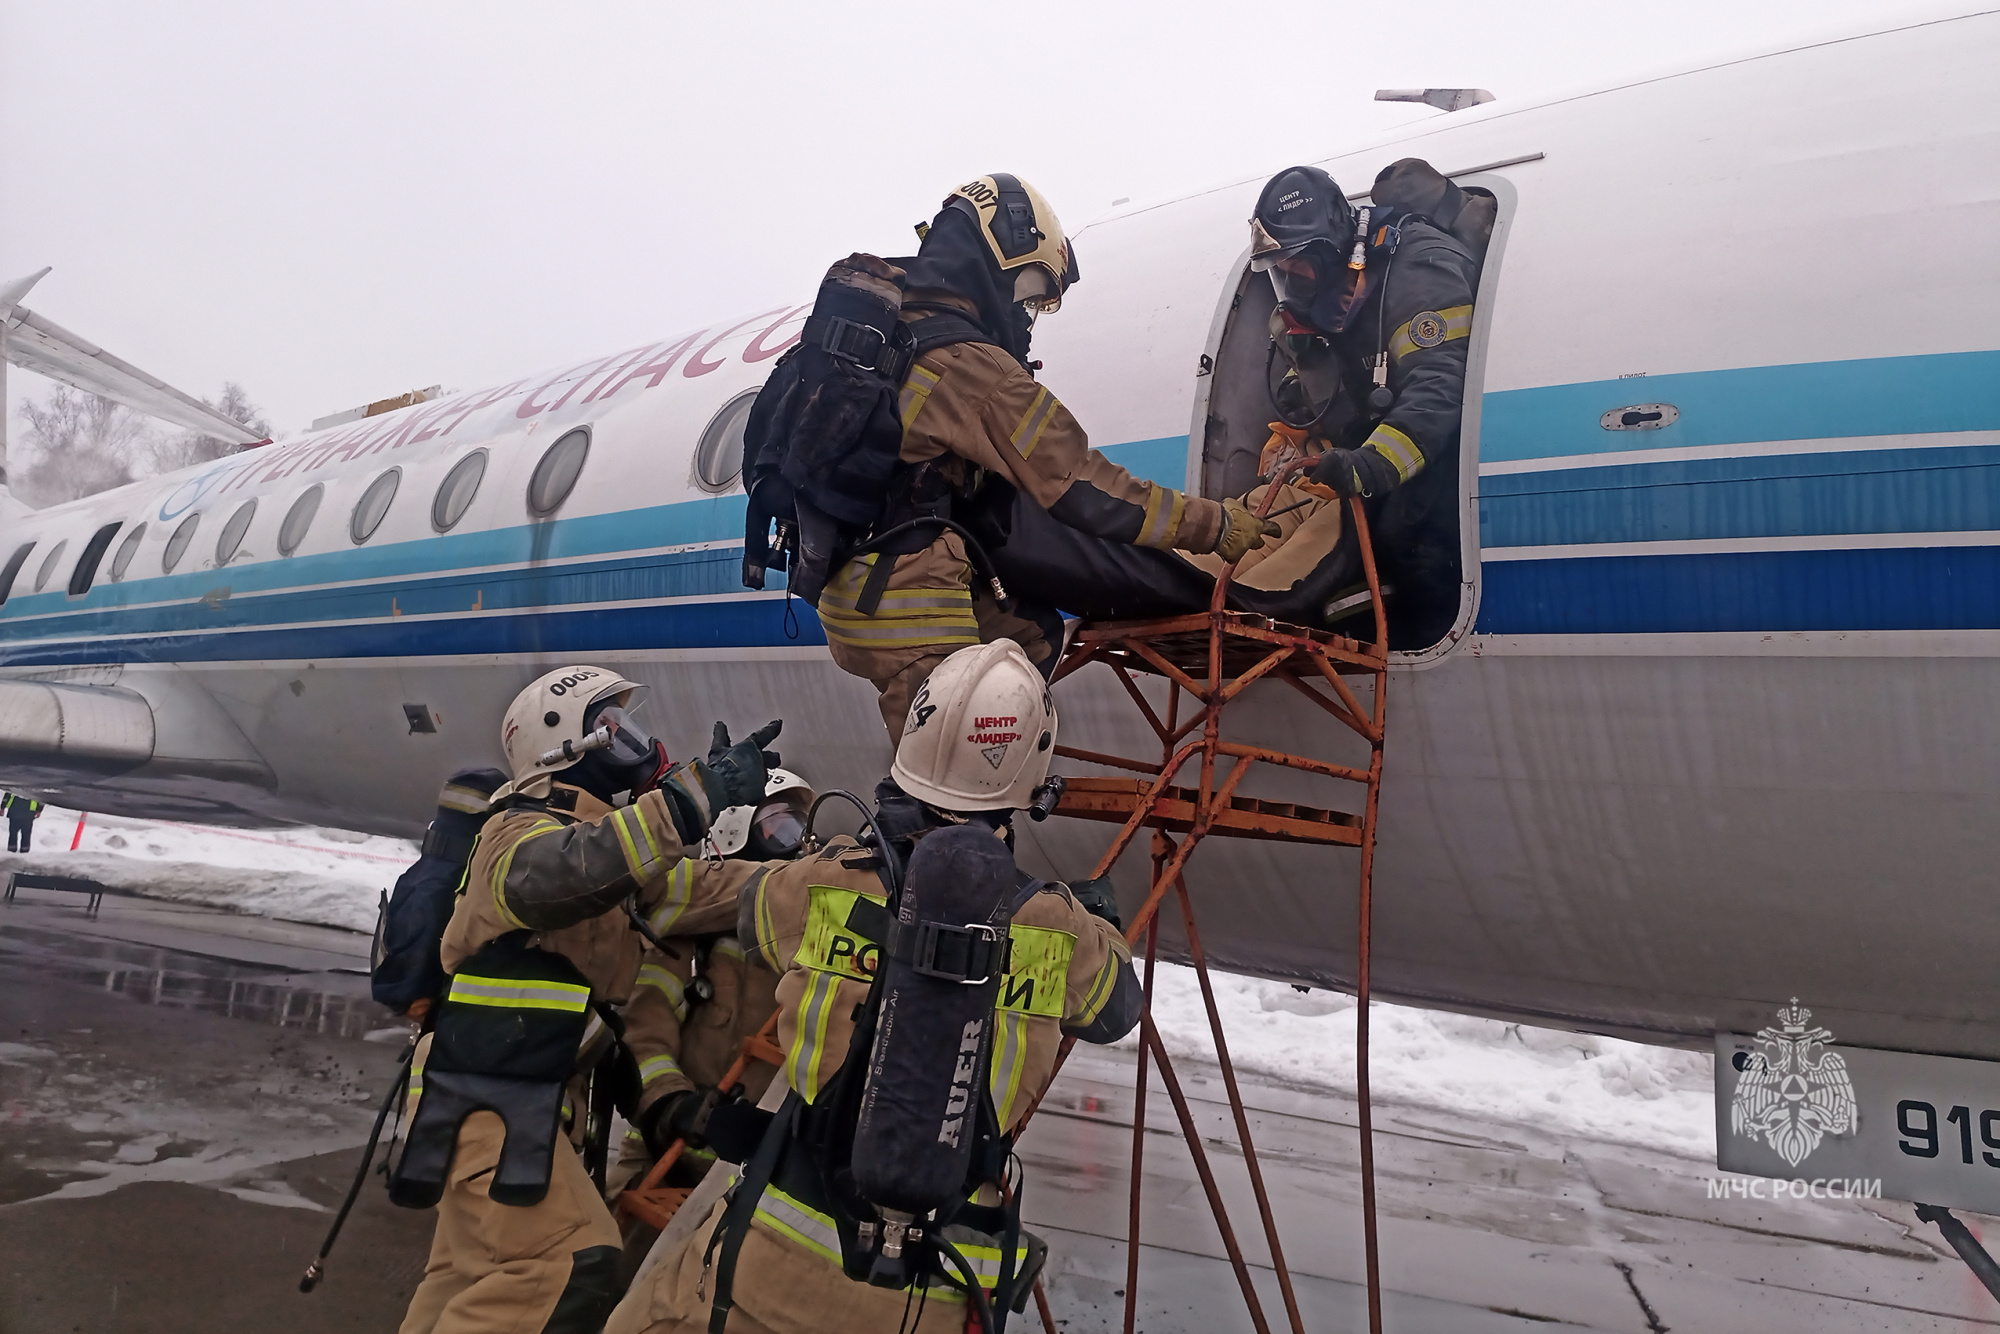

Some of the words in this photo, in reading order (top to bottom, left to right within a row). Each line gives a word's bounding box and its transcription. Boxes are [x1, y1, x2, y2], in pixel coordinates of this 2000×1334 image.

[960, 180, 998, 210] 0007
[1279, 190, 1300, 203] ЦЕНТР
[549, 671, 600, 697] 0005
[974, 716, 1018, 730] ЦЕНТР
[967, 732, 1022, 745] «ЛИДЕР»
[890, 988, 900, 1008] Air
[937, 1018, 984, 1149] AUER
